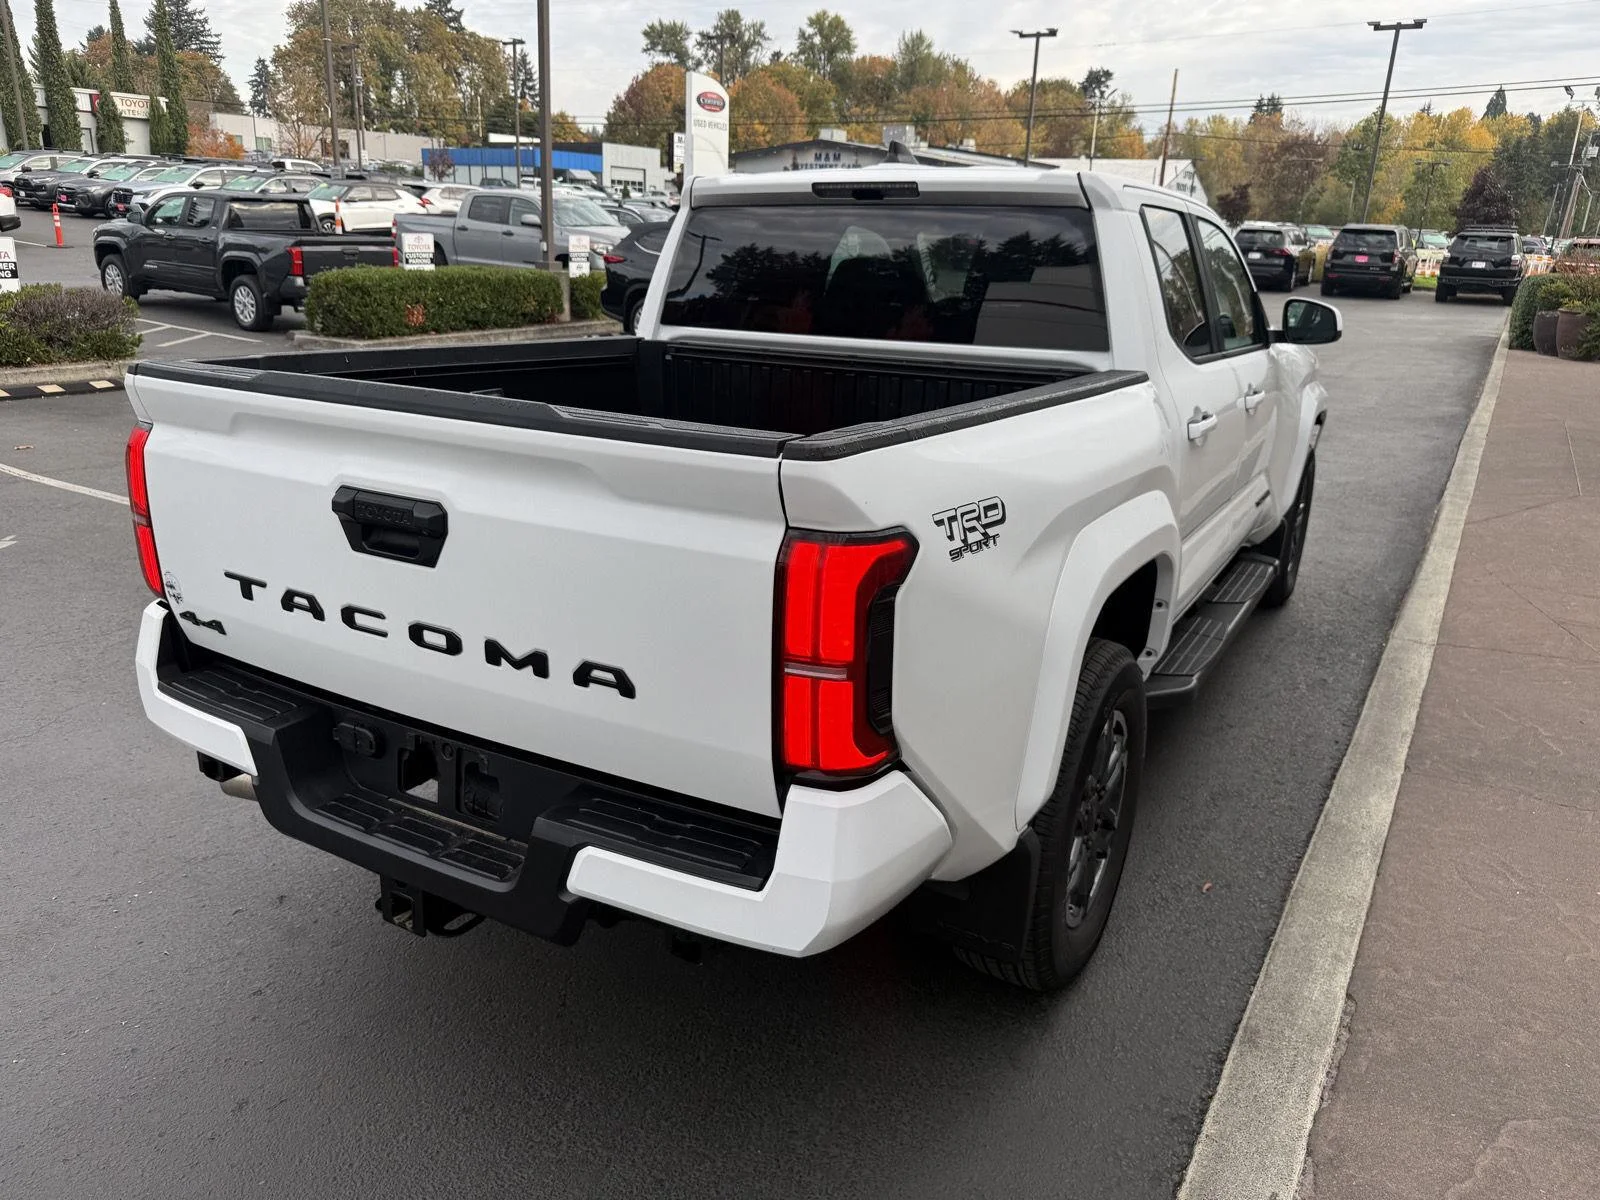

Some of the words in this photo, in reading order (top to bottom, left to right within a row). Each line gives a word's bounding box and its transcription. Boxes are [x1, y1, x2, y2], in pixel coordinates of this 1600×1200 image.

[120, 98, 150, 109] TOYOT
[932, 496, 1006, 546] TRD
[949, 533, 1000, 562] SPORT
[223, 569, 636, 699] TACOMA
